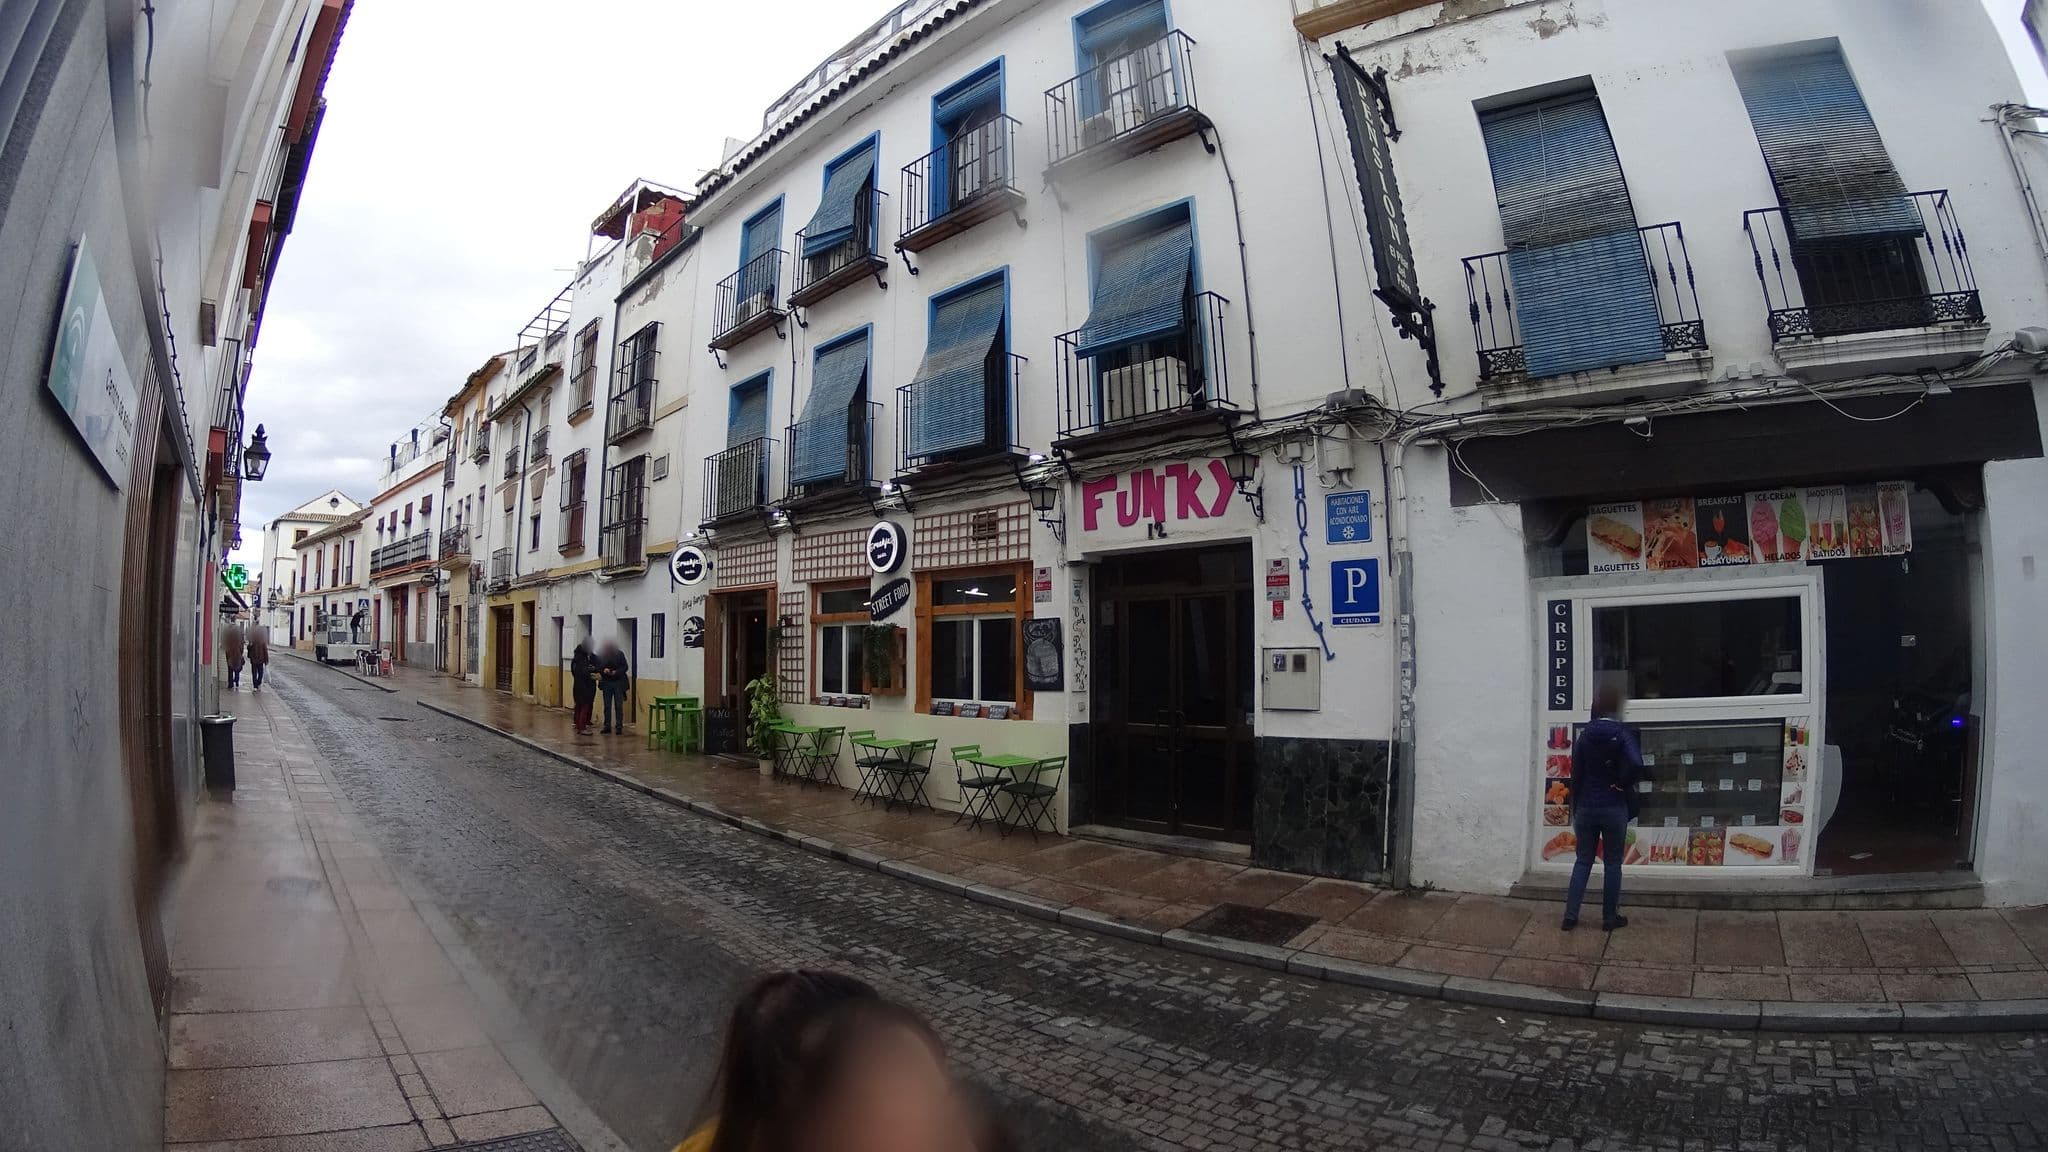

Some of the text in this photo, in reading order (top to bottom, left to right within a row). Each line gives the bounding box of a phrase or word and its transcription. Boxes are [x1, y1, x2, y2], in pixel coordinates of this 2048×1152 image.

[1082, 458, 1259, 532] FUNKY
[1330, 495, 1365, 506] HABITACIONES
[1698, 495, 1742, 506] BREAKFAST
[1754, 491, 1797, 502] ICE-CREAM
[1591, 503, 1637, 515] BAGUETTES
[1329, 514, 1368, 526] ACONDICIONADO
[1764, 552, 1802, 562] HELADOS
[1813, 548, 1846, 559] BATIDOS
[1593, 562, 1640, 573] BAGUETTES
[1343, 567, 1367, 604] P
[871, 582, 910, 616] STREET FOOD
[1340, 617, 1371, 625] CIUDAD
[1554, 603, 1567, 705] CREPES
